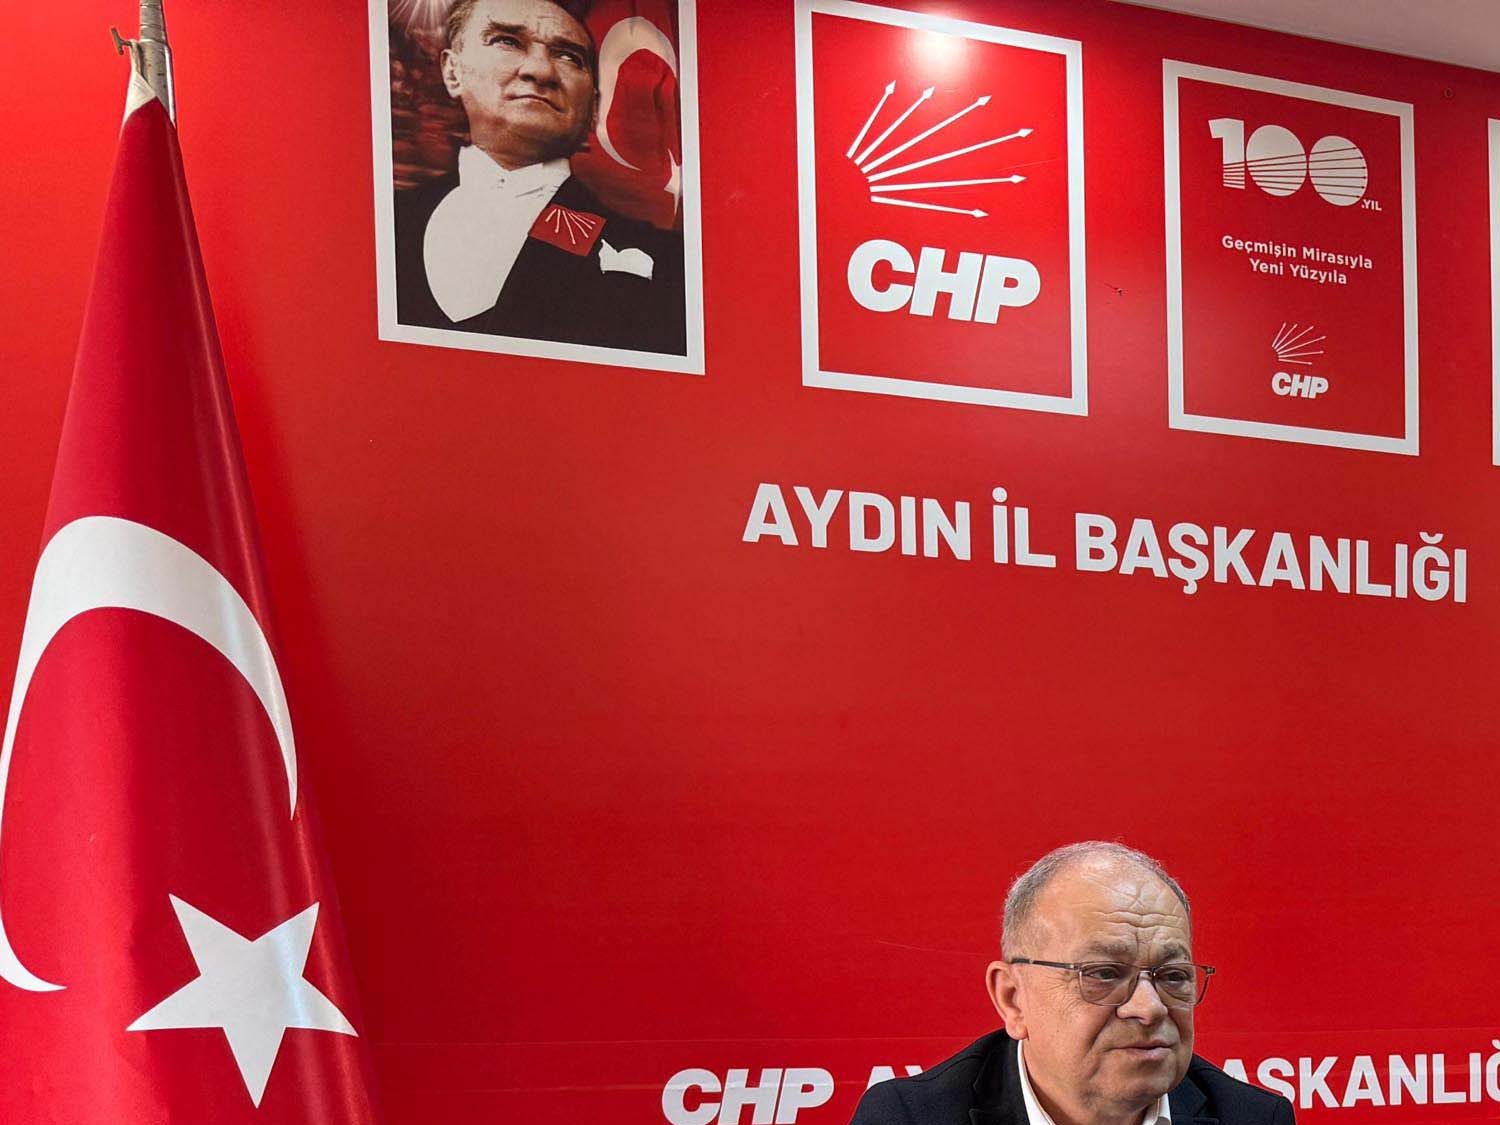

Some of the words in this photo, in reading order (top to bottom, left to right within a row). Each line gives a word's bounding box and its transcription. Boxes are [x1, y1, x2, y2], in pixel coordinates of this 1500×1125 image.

[1208, 117, 1368, 207] 100
[848, 239, 1041, 325] CHP
[1221, 235, 1297, 259] Geçmişin
[1302, 246, 1373, 270] Mirasıyla
[1249, 258, 1284, 276] Yeni
[1290, 264, 1347, 285] Yüzyıla
[1271, 371, 1329, 400] CHP
[742, 482, 971, 561] AYDIN
[991, 486, 1057, 568] İL
[1075, 512, 1468, 603] BAŞKANLIĞI
